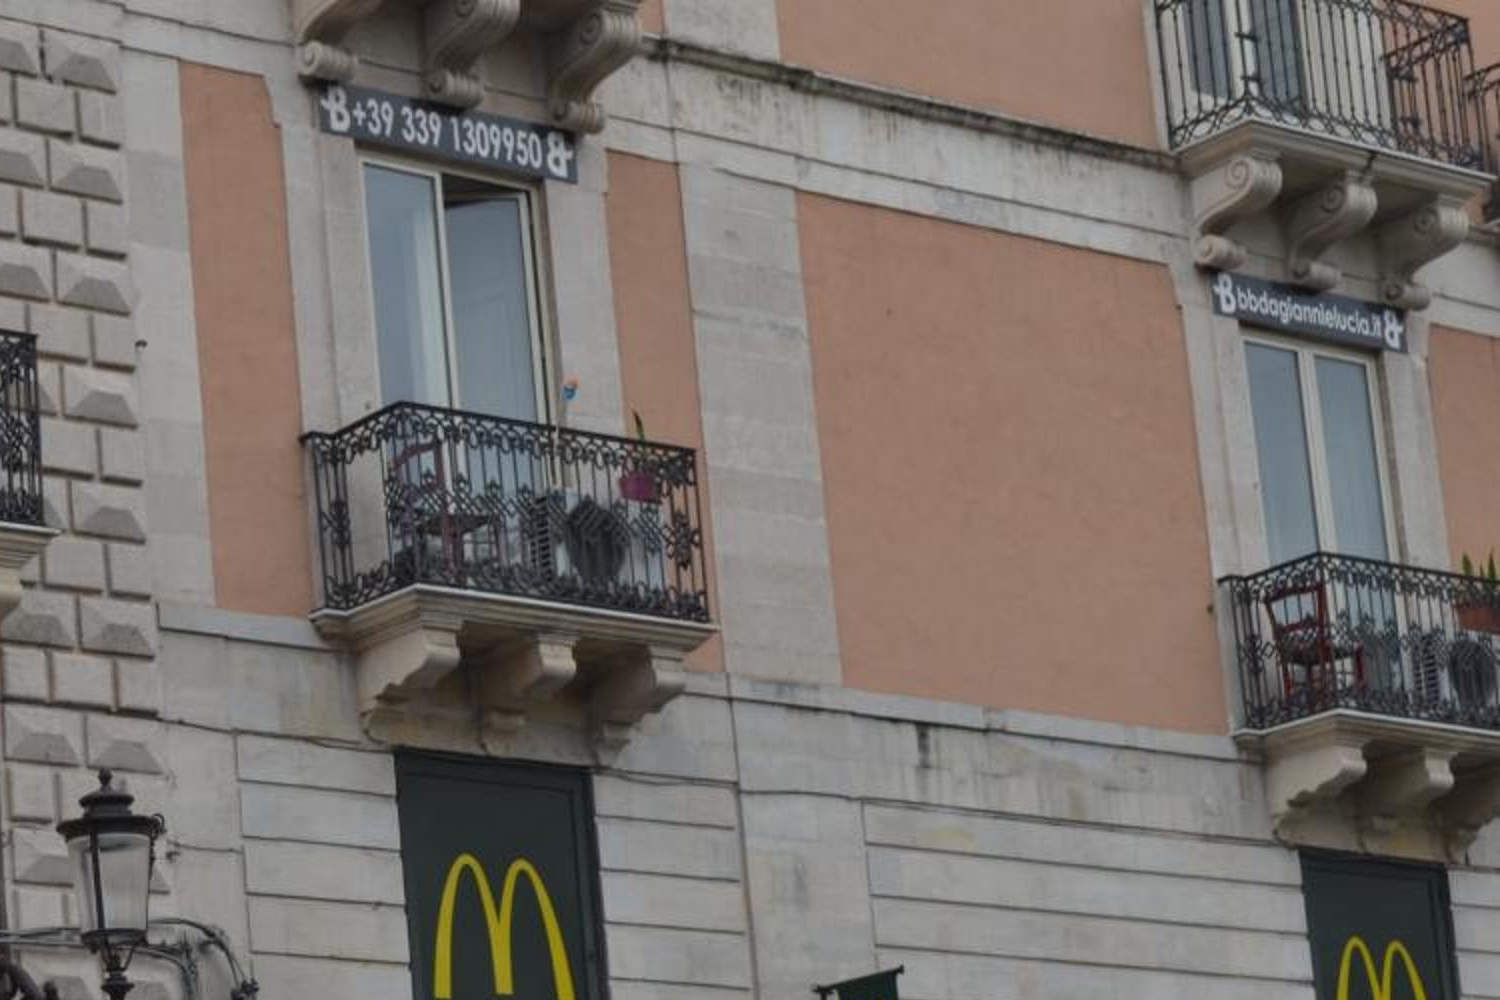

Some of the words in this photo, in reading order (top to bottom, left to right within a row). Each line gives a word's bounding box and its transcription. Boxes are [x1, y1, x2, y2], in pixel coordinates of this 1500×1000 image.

[353, 98, 395, 137] +39
[401, 105, 443, 147] 339
[451, 116, 543, 169] 1309950
